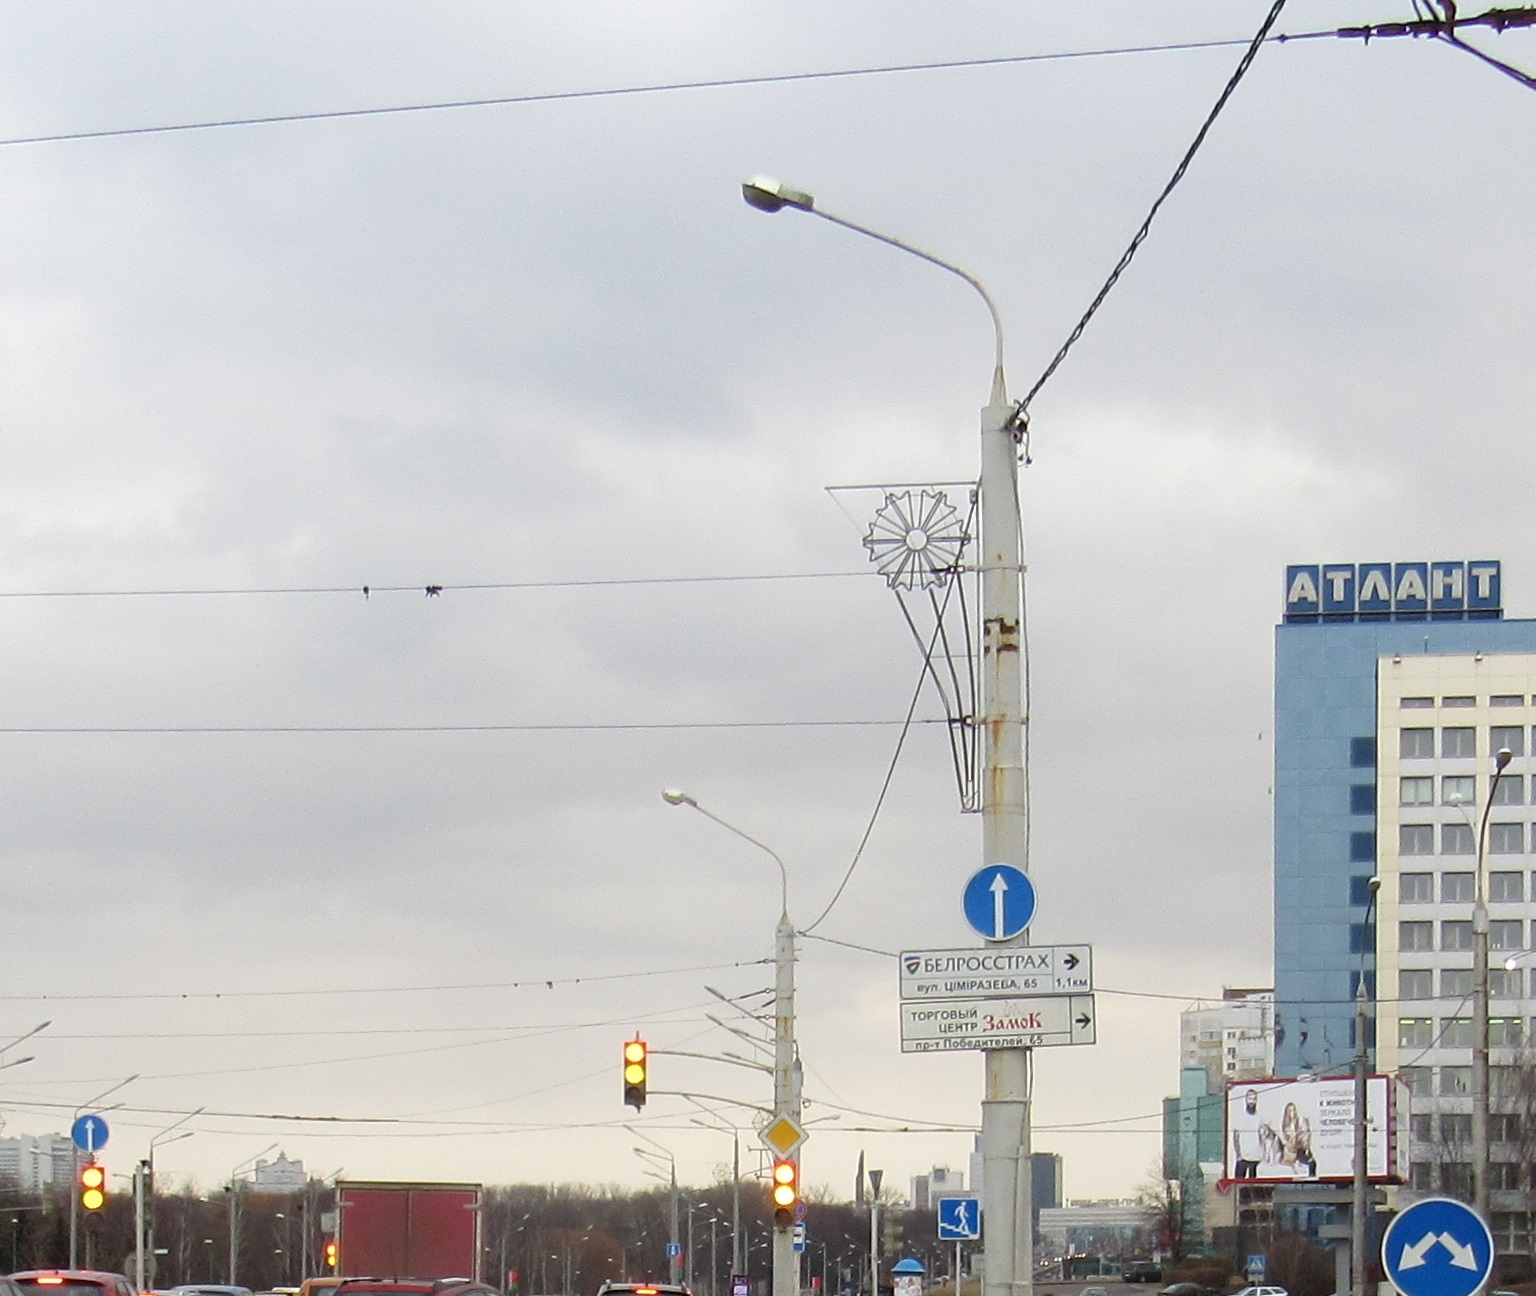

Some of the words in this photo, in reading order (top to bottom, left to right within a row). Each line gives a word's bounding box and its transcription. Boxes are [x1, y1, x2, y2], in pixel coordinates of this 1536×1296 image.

[1287, 568, 1498, 603] АТЛАНТ
[924, 954, 1049, 973] БЕЛРОССТРАХ
[1024, 978, 1038, 989] 65
[911, 1006, 978, 1021] ТОРГОВЫЙ
[939, 1022, 978, 1034] ЦЕНТР
